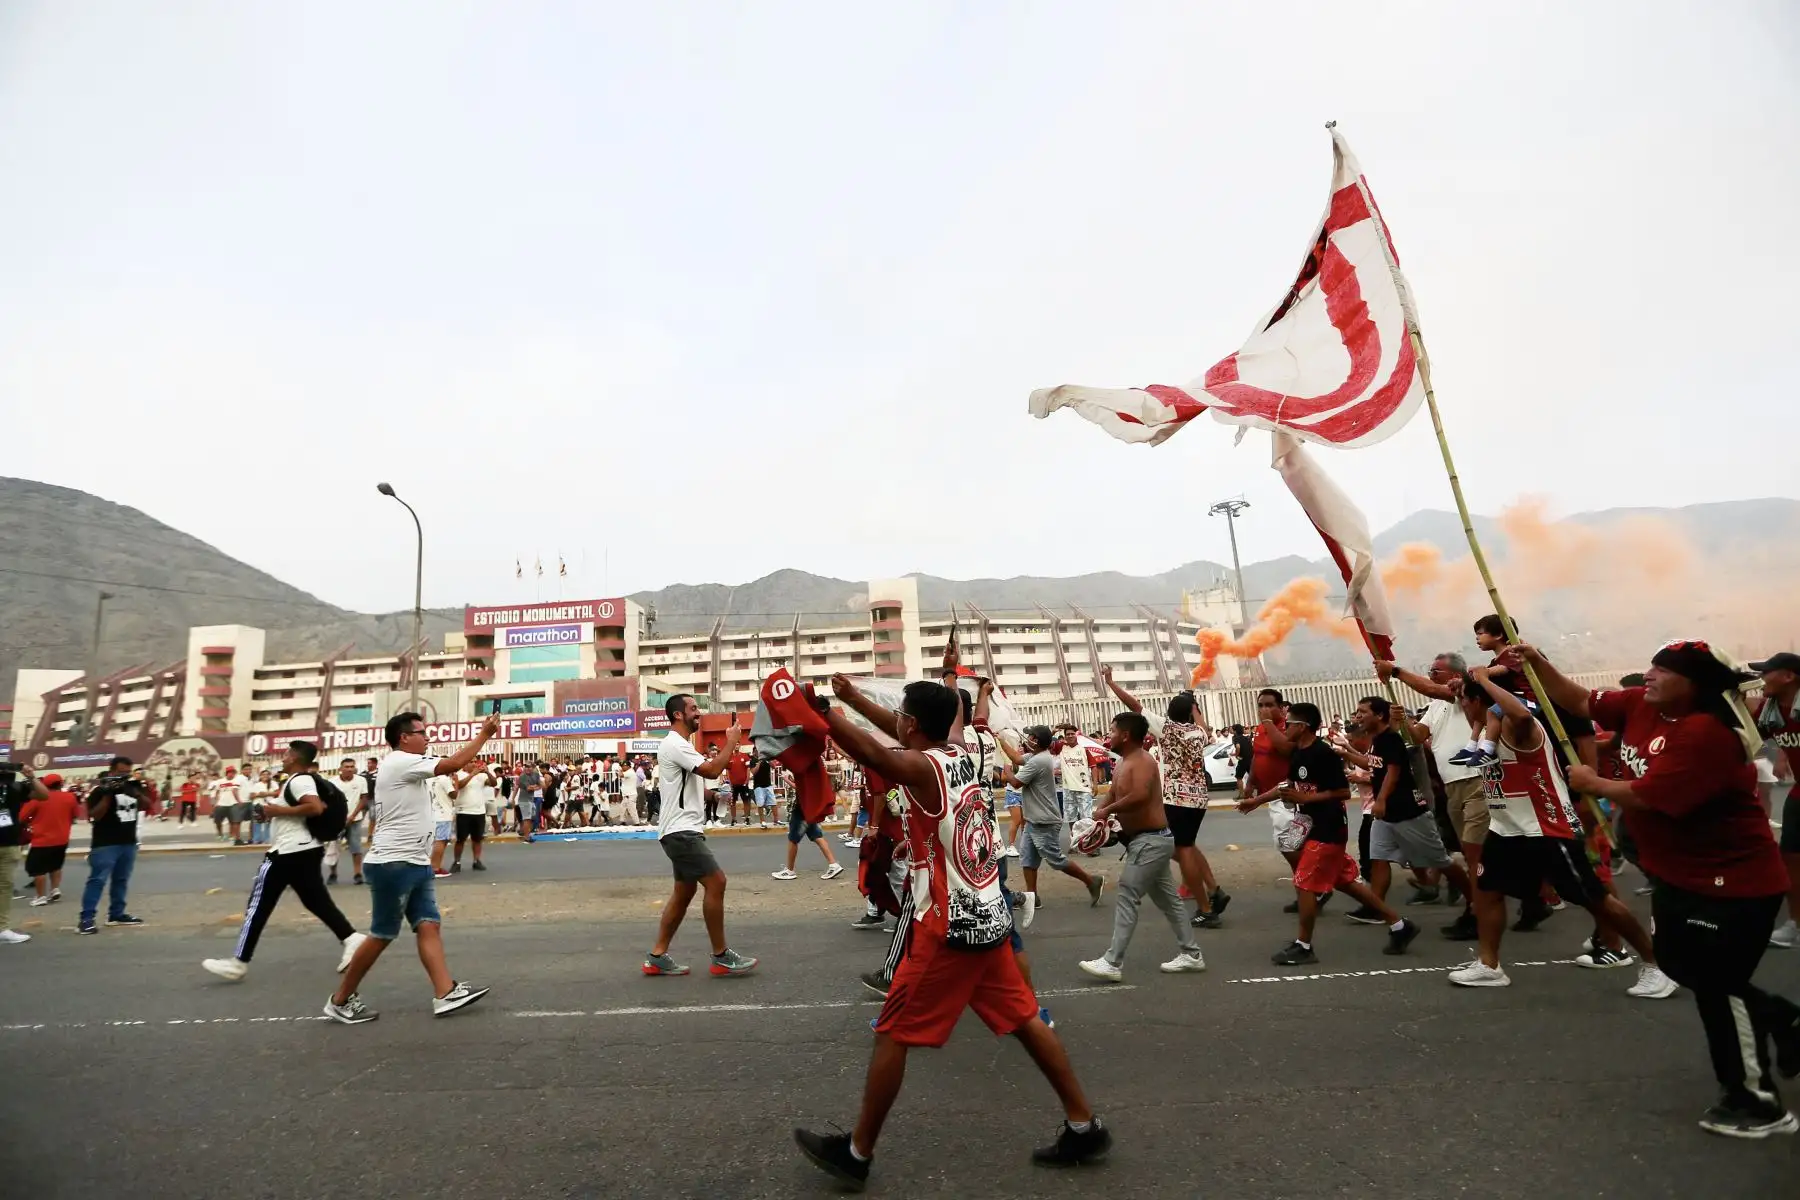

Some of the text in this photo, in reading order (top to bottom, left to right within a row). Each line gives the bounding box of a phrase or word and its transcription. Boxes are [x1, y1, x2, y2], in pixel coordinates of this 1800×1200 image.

[474, 605, 595, 626] ESTADIO MONUMENTAL
[508, 629, 579, 644] marathon
[565, 700, 627, 714] marathon
[531, 717, 632, 731] marathon.com.pe
